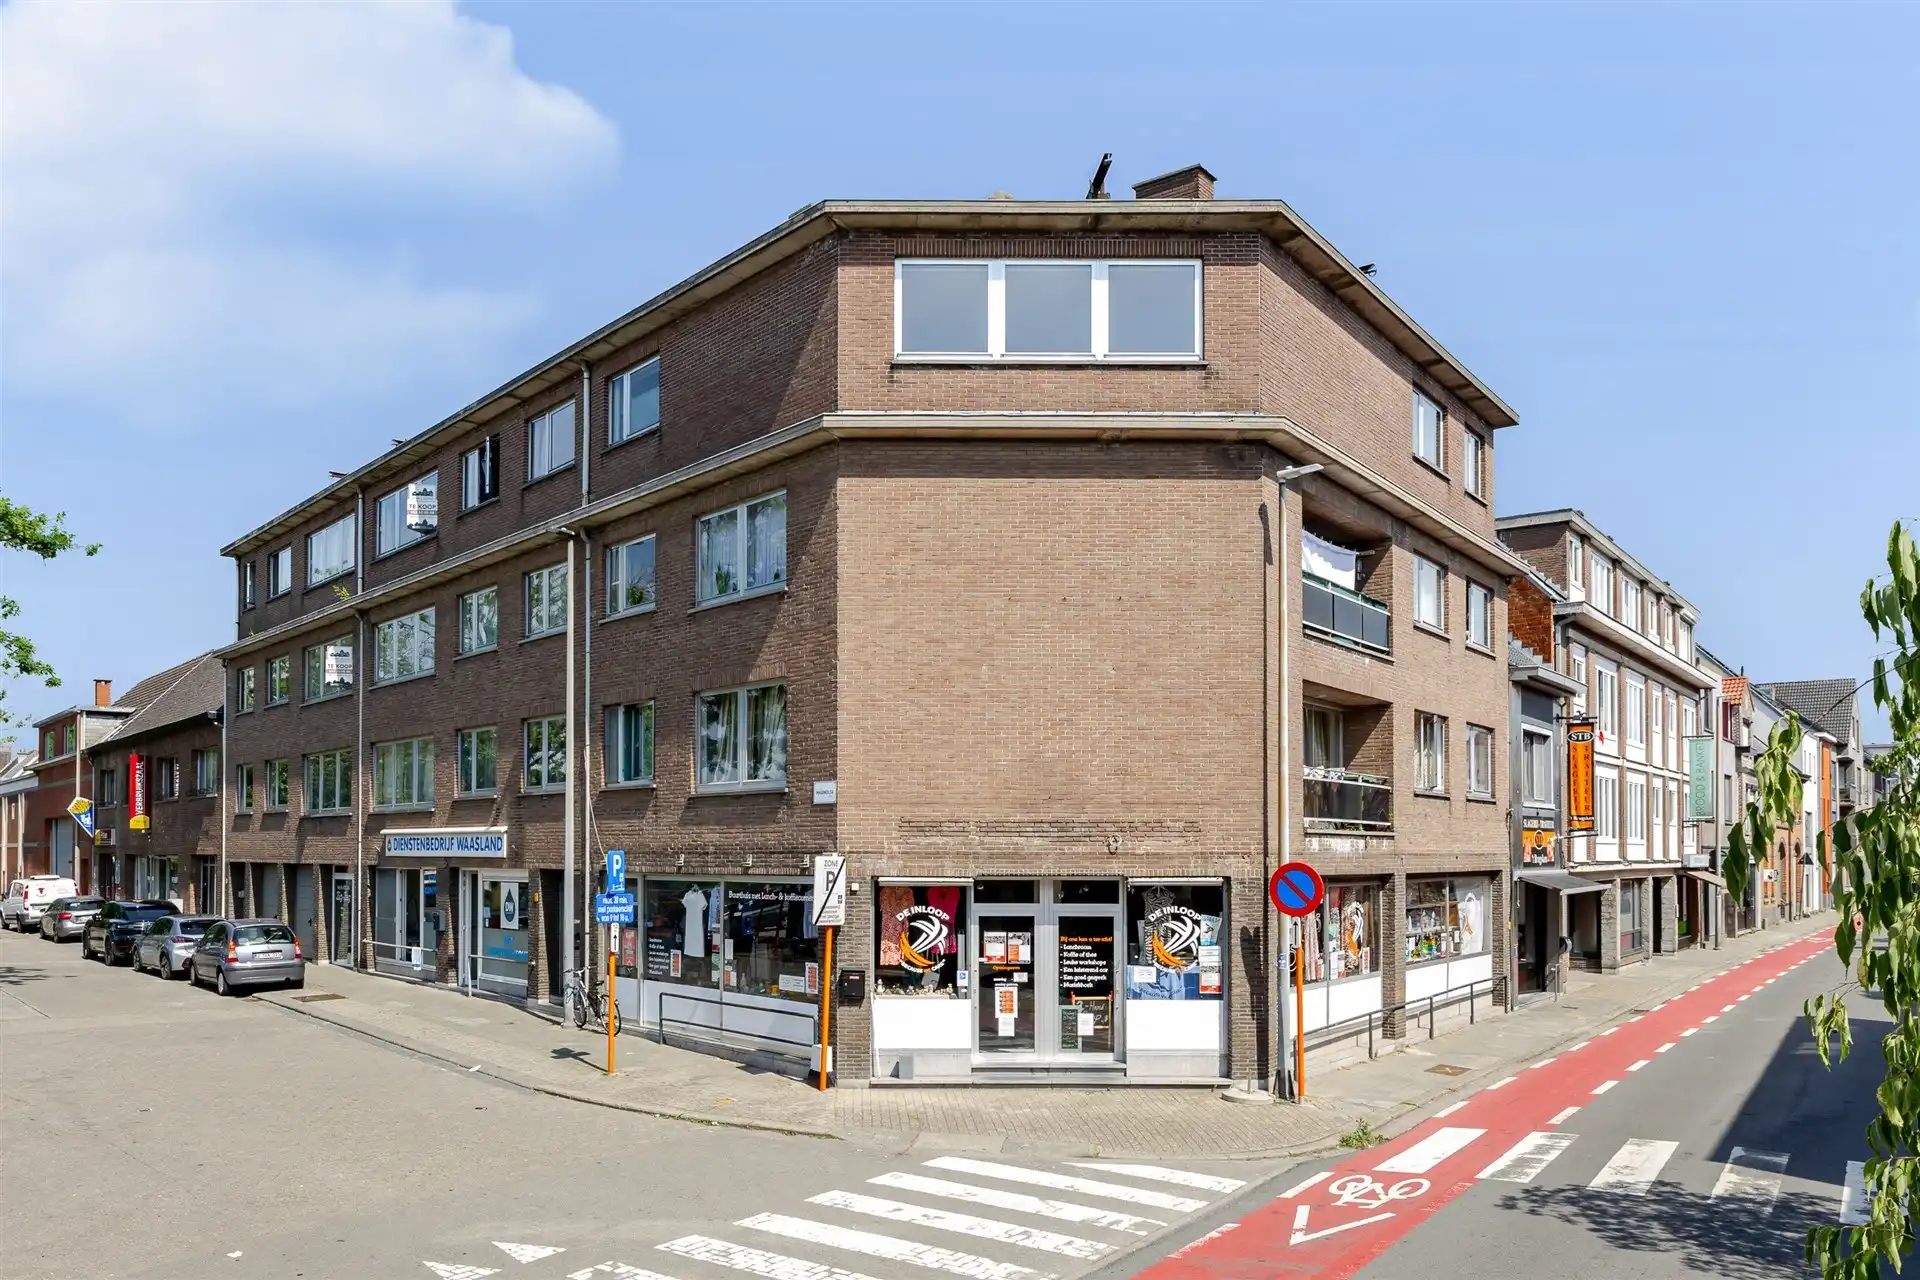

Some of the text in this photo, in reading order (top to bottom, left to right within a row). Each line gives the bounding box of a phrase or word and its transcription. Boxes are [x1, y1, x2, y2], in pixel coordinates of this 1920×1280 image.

[136, 762, 144, 815] VERBRUIKSZAAL
[1696, 784, 1705, 816] BROOD
[393, 836, 503, 852] DIENSTENBEDRIJF WAASLAND
[613, 854, 622, 877] P
[826, 870, 835, 892] P
[896, 905, 950, 921] DE INLOOP
[1148, 906, 1202, 921] DE INLOOP
